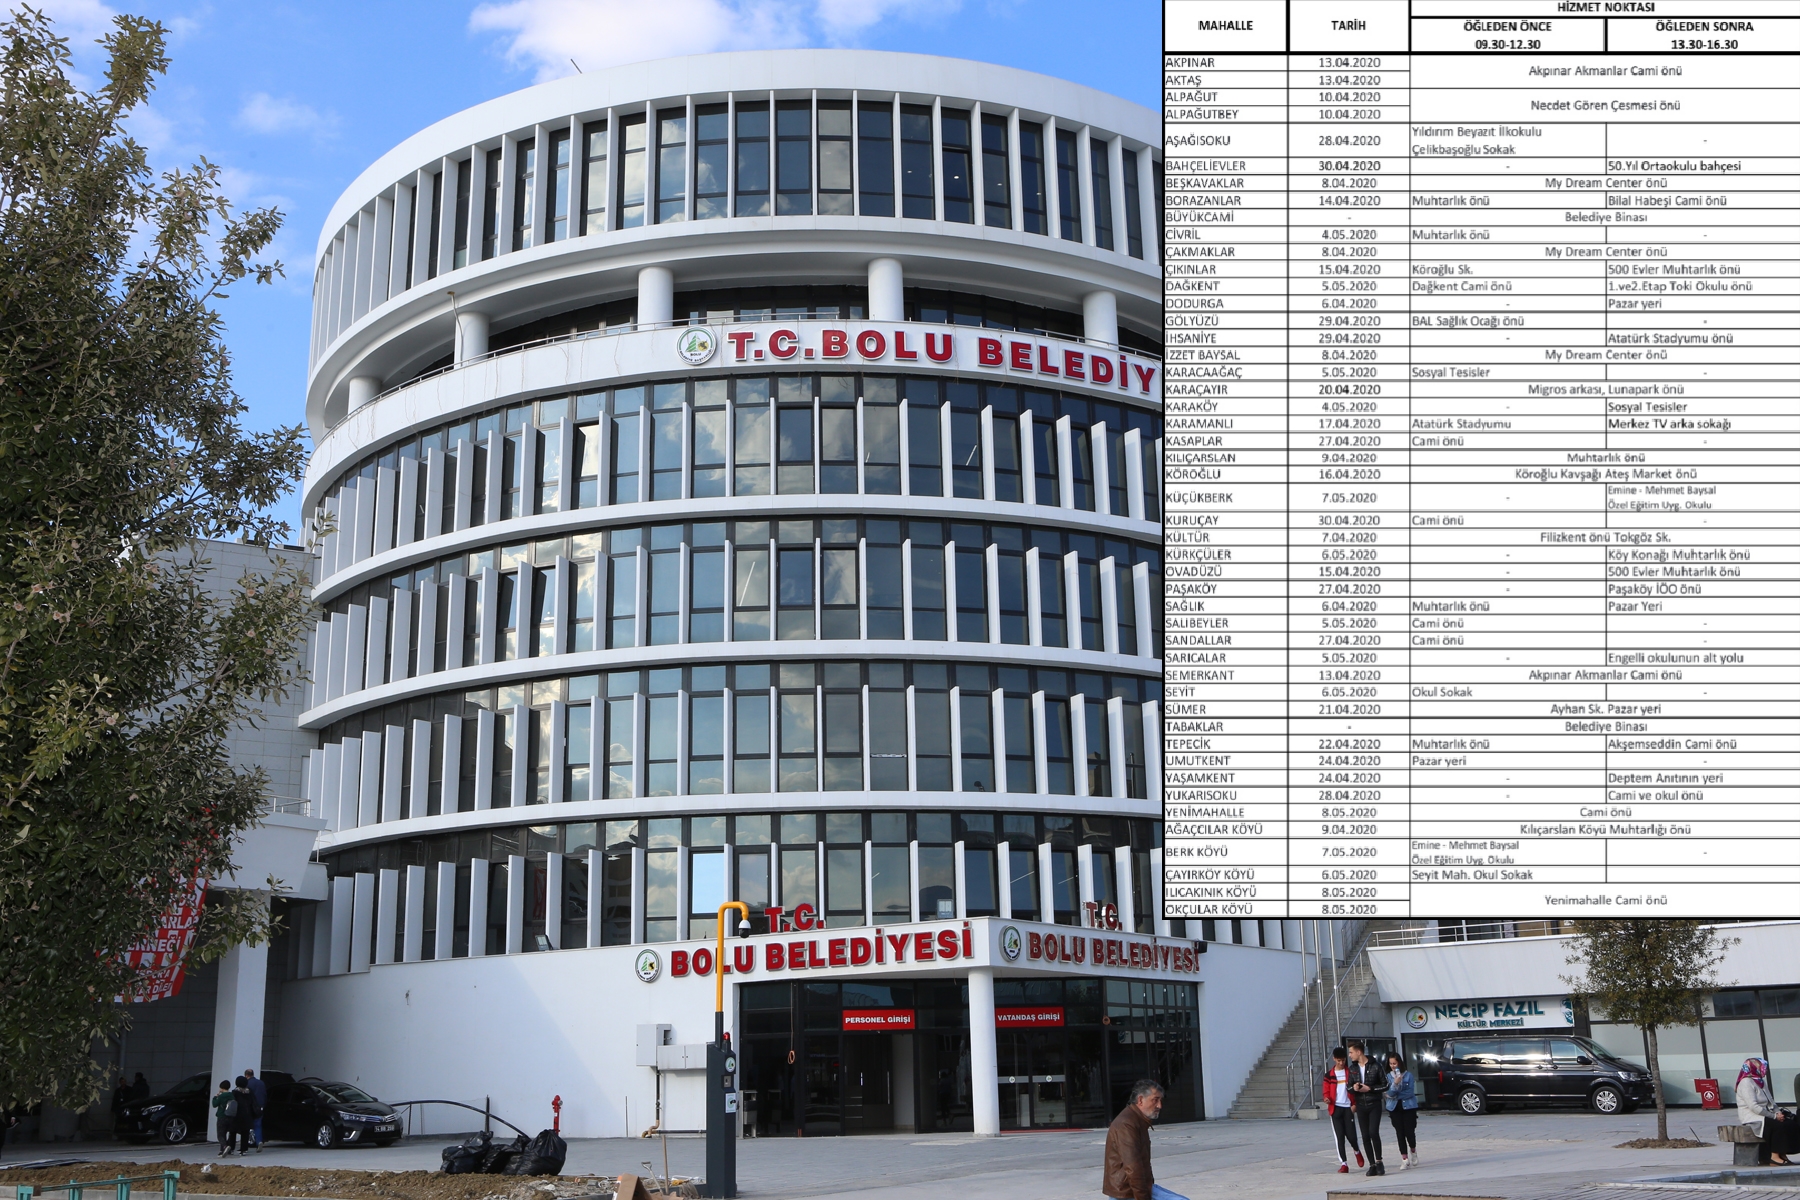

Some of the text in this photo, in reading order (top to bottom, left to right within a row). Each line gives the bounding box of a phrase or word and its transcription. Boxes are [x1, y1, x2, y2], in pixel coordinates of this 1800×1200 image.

[764, 902, 825, 934] T.C.
[1082, 900, 1123, 931] T.C.
[765, 921, 974, 972] BELEDİYESİ
[1026, 931, 1201, 974] BOLU BELEDİYESİ
[887, 1015, 911, 1025] GİRİŞİ
[997, 1012, 1060, 1023] VATANDAŞ GİRİŞİ
[1493, 1000, 1545, 1017] FAZIL
[1457, 1017, 1524, 1029] KÜLTÜR MERKEZİ
